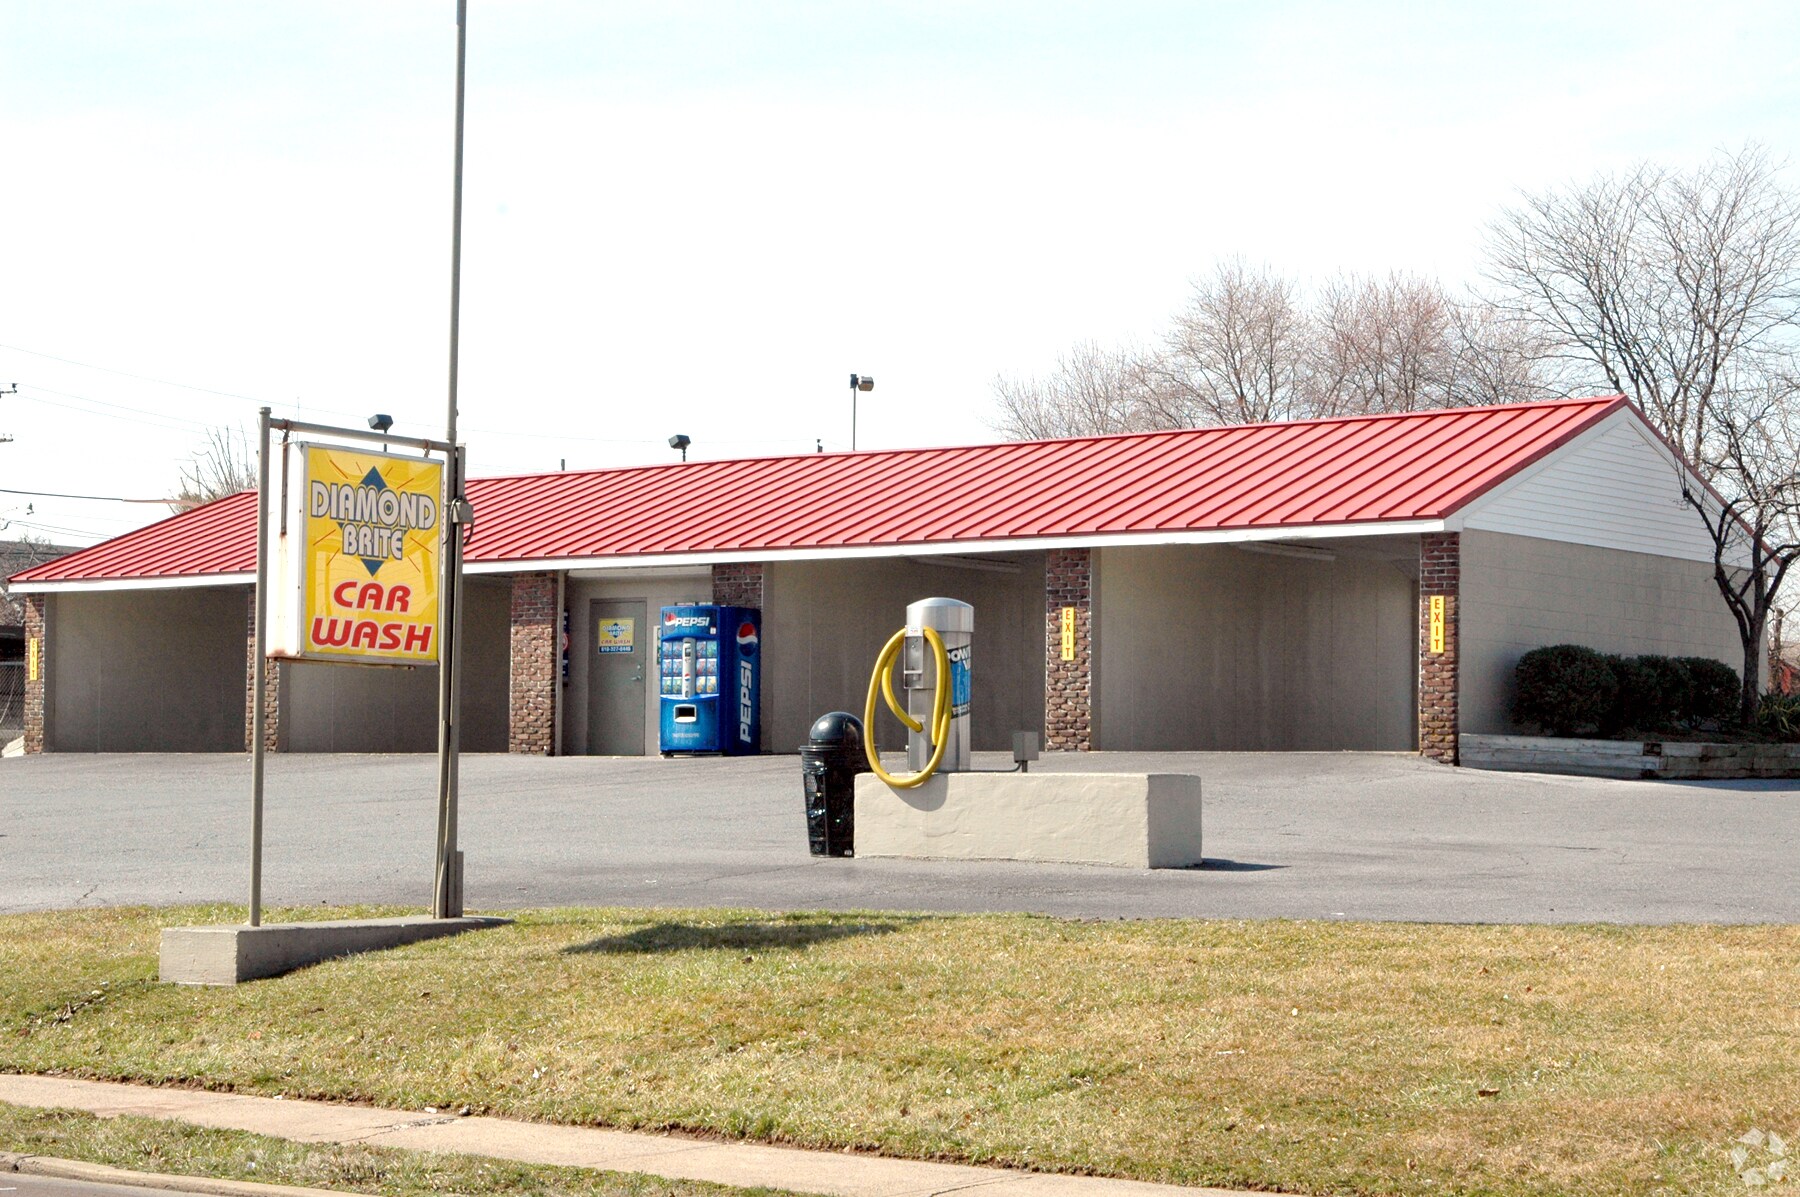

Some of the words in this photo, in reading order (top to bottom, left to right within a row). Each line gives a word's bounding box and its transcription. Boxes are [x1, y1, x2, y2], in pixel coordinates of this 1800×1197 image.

[310, 480, 437, 530] DIAMOND
[342, 522, 403, 560] BRITE
[333, 580, 411, 613] CAR
[310, 617, 432, 652] WASH
[602, 624, 631, 632] DIAMOND
[674, 616, 710, 627] PEPSI
[1433, 598, 1441, 650] EXIT
[739, 659, 752, 744] PEPSI
